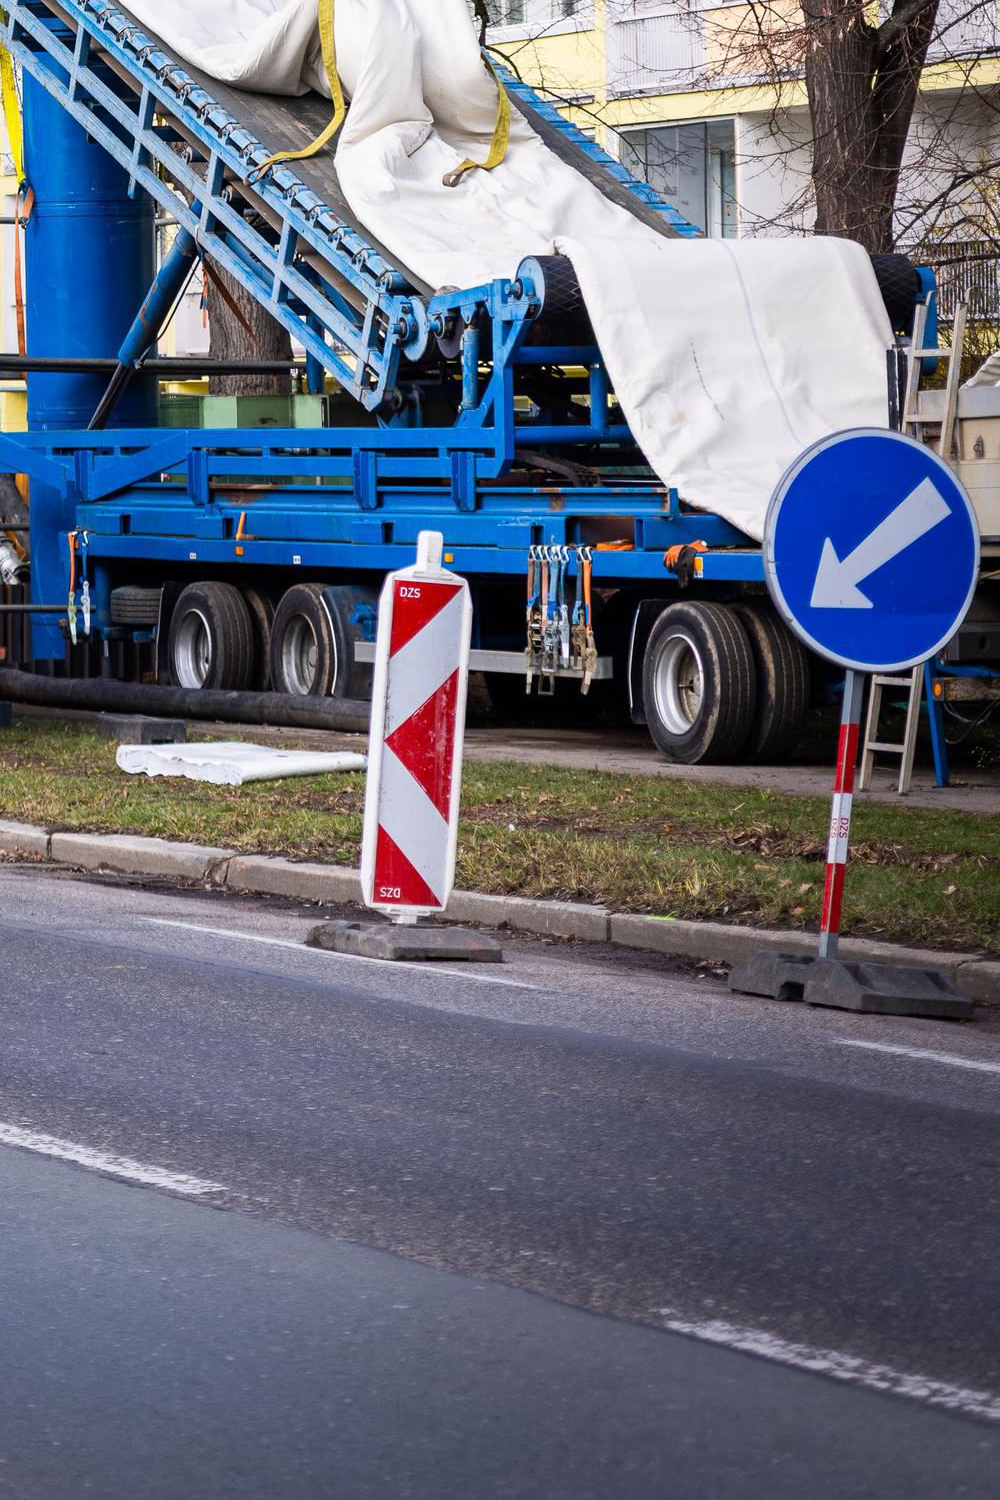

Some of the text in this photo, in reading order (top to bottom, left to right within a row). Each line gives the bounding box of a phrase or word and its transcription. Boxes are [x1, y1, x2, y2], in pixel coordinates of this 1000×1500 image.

[400, 587, 421, 599] DZS
[839, 817, 849, 839] DZS
[380, 887, 401, 899] DZS
